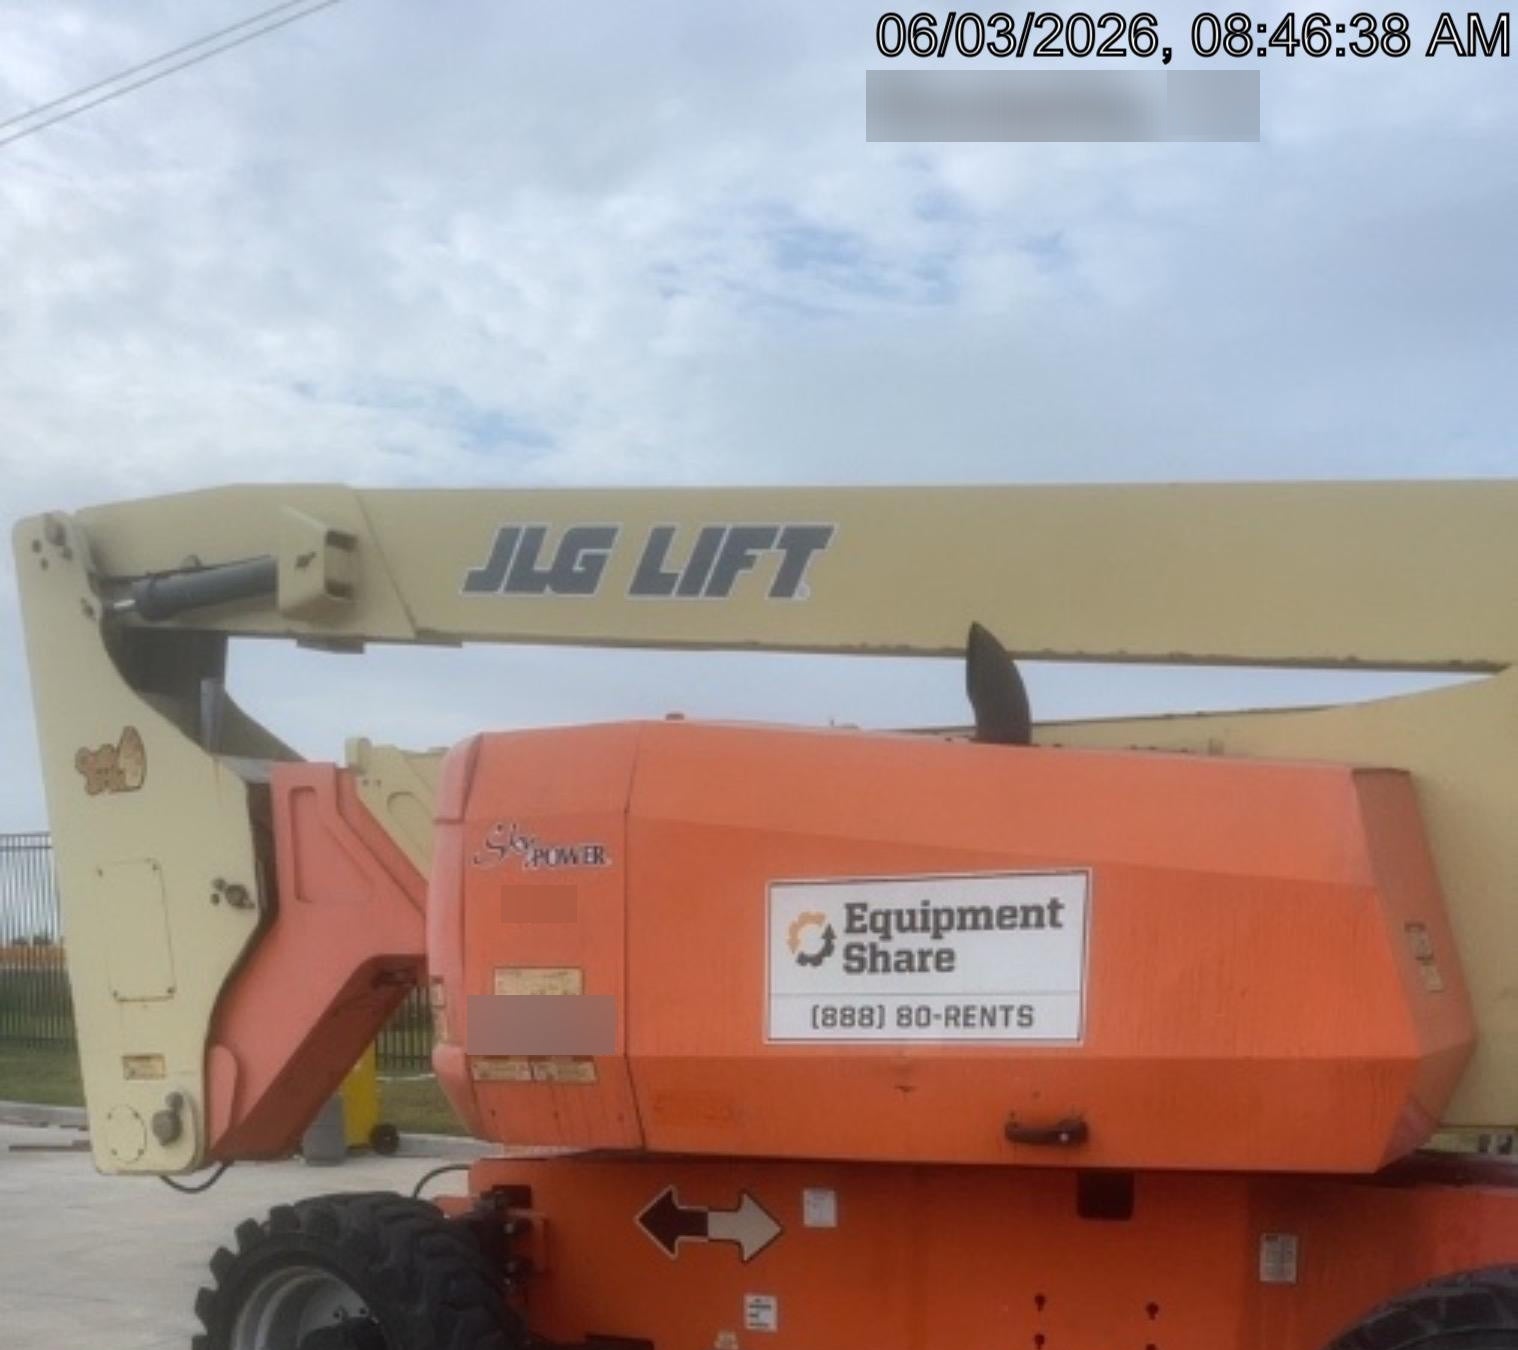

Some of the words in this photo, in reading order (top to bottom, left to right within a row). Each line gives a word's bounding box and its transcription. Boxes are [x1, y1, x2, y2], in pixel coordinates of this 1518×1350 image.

[460, 523, 622, 596] JLG
[626, 524, 839, 601] LIFT
[530, 845, 606, 867] POWER
[843, 897, 1065, 940] Equipment
[843, 942, 956, 975] Share
[896, 1004, 1035, 1029] 80-RENTS
